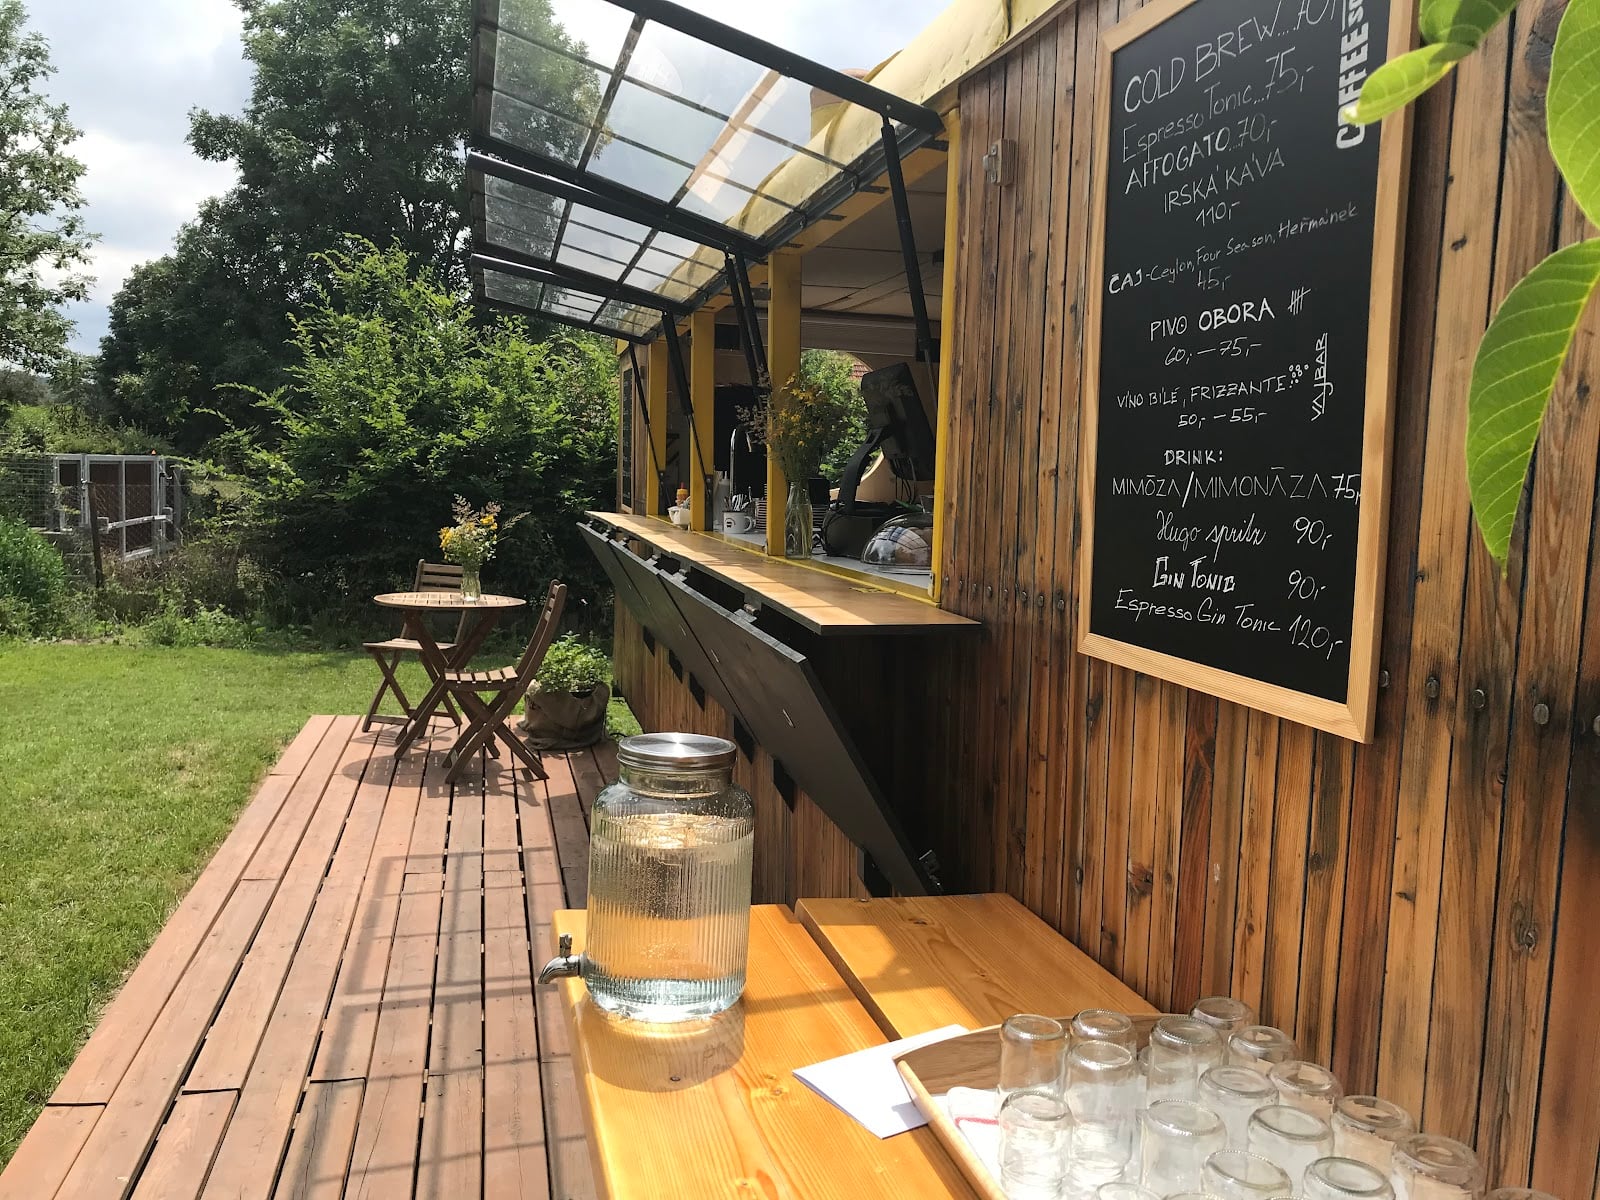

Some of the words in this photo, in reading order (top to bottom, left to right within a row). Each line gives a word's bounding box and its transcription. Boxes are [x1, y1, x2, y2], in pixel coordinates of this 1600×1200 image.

[1124, 57, 1186, 113] COLD
[1122, 112, 1204, 163] Espresso
[1195, 246, 1221, 266] Four
[1149, 315, 1188, 342] PIVO
[1198, 297, 1275, 331] OBORA
[1190, 375, 1287, 403] FRIZZANTE
[1163, 449, 1223, 466] DRINK:
[1156, 509, 1202, 552] Hugo
[1114, 588, 1193, 622] Espresso
[1196, 596, 1226, 625] Gin
[1234, 603, 1281, 632] Tonic
